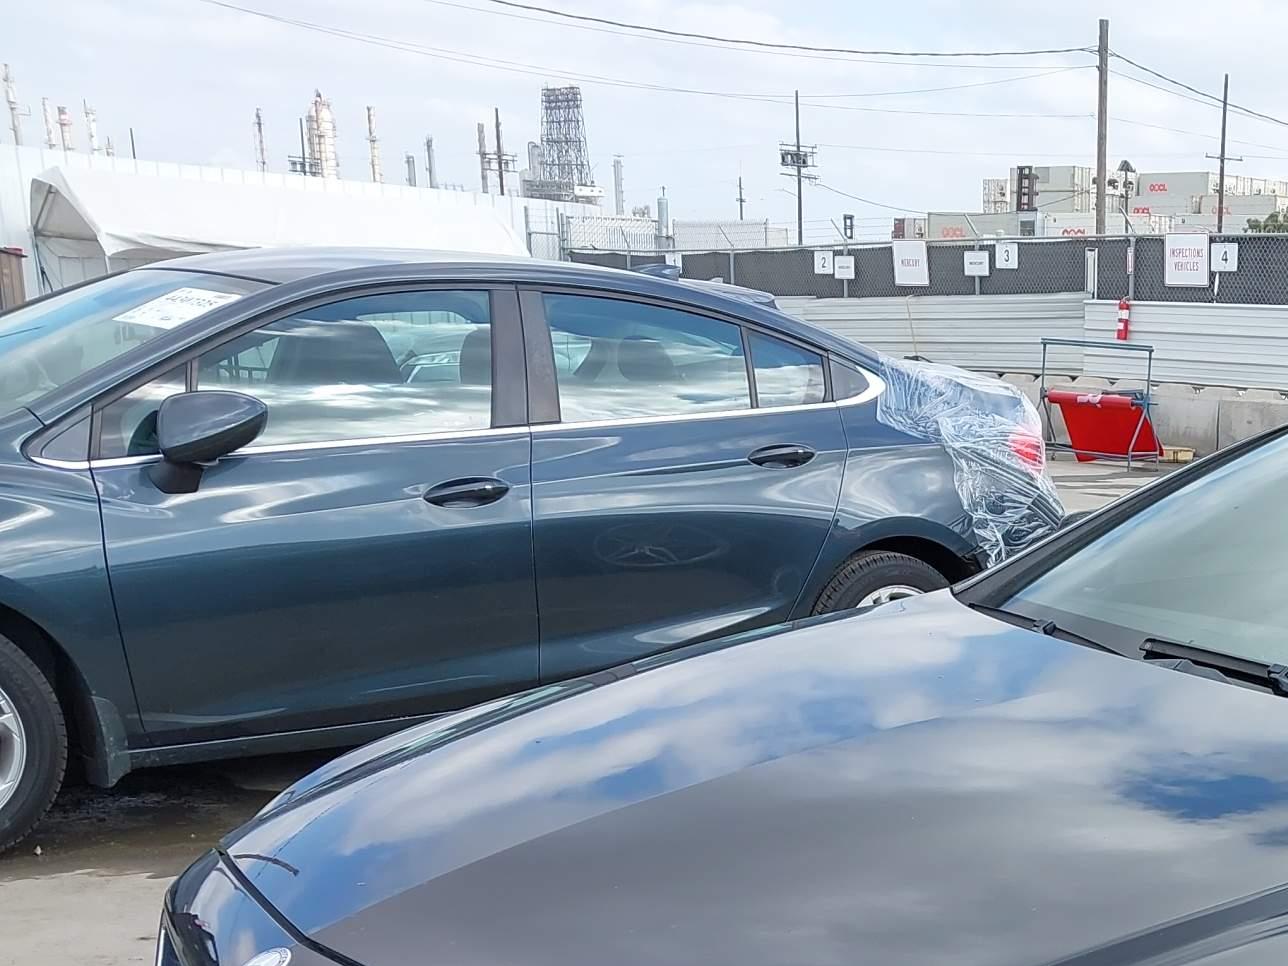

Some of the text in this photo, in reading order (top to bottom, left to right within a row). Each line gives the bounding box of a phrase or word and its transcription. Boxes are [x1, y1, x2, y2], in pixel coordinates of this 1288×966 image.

[1003, 249, 1010, 263] 3
[1169, 247, 1204, 258] INSPECTIONS
[1221, 250, 1229, 264] 4
[821, 256, 827, 269] 2
[1173, 261, 1199, 272] VEHICLES
